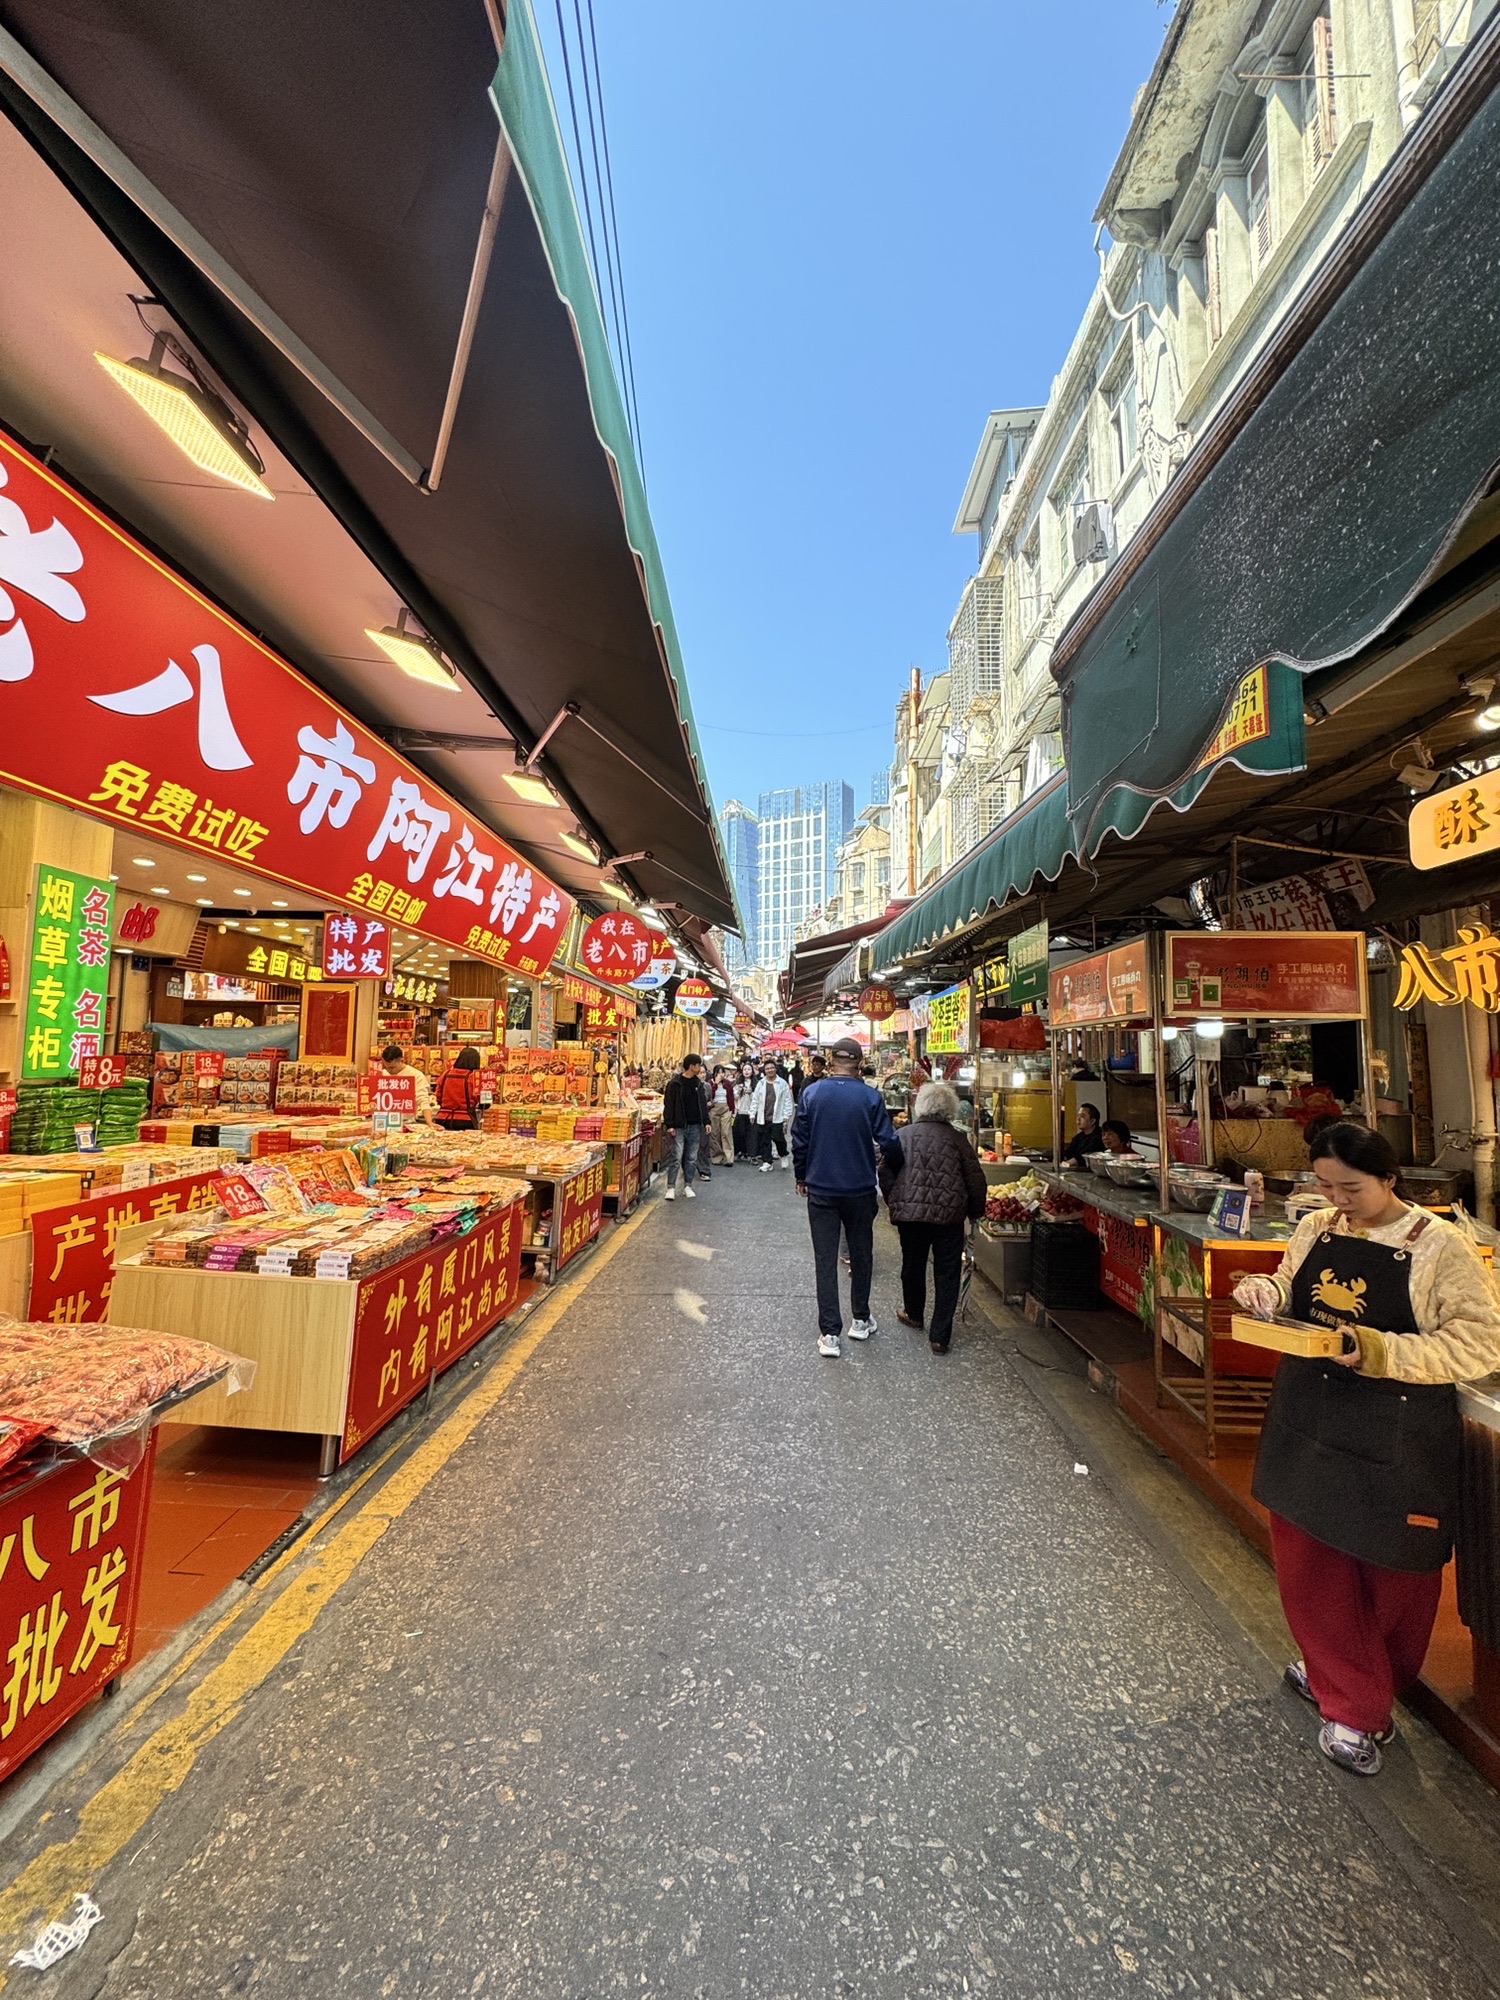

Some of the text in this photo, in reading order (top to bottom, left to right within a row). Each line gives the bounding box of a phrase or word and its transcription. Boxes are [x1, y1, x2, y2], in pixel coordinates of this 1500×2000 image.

[1236, 678, 1258, 702] 64
[89, 760, 270, 861] 免费试吃
[1434, 788, 1500, 850] 酥
[346, 872, 427, 925] 全国包邮
[77, 886, 110, 967] 名茶
[120, 902, 160, 943] 邮
[328, 917, 386, 946] 特产
[601, 917, 635, 936] 我在
[327, 948, 385, 976] 批发
[463, 924, 511, 961] 免费试吃
[586, 937, 649, 967] 老八市
[28, 874, 75, 1071] 烟草专柜
[1393, 928, 1500, 1011] 八市
[587, 1008, 618, 1027] 批发
[82, 1059, 98, 1086] 特价
[377, 1079, 410, 1090] 批发价
[372, 1091, 414, 1111] 10元/包
[225, 1184, 249, 1204] 18
[562, 1209, 591, 1259] 批发价
[384, 1217, 511, 1336] 外有厦门风景
[378, 1267, 509, 1408] 内有阿江尚品
[1, 1545, 128, 1741] 批发
